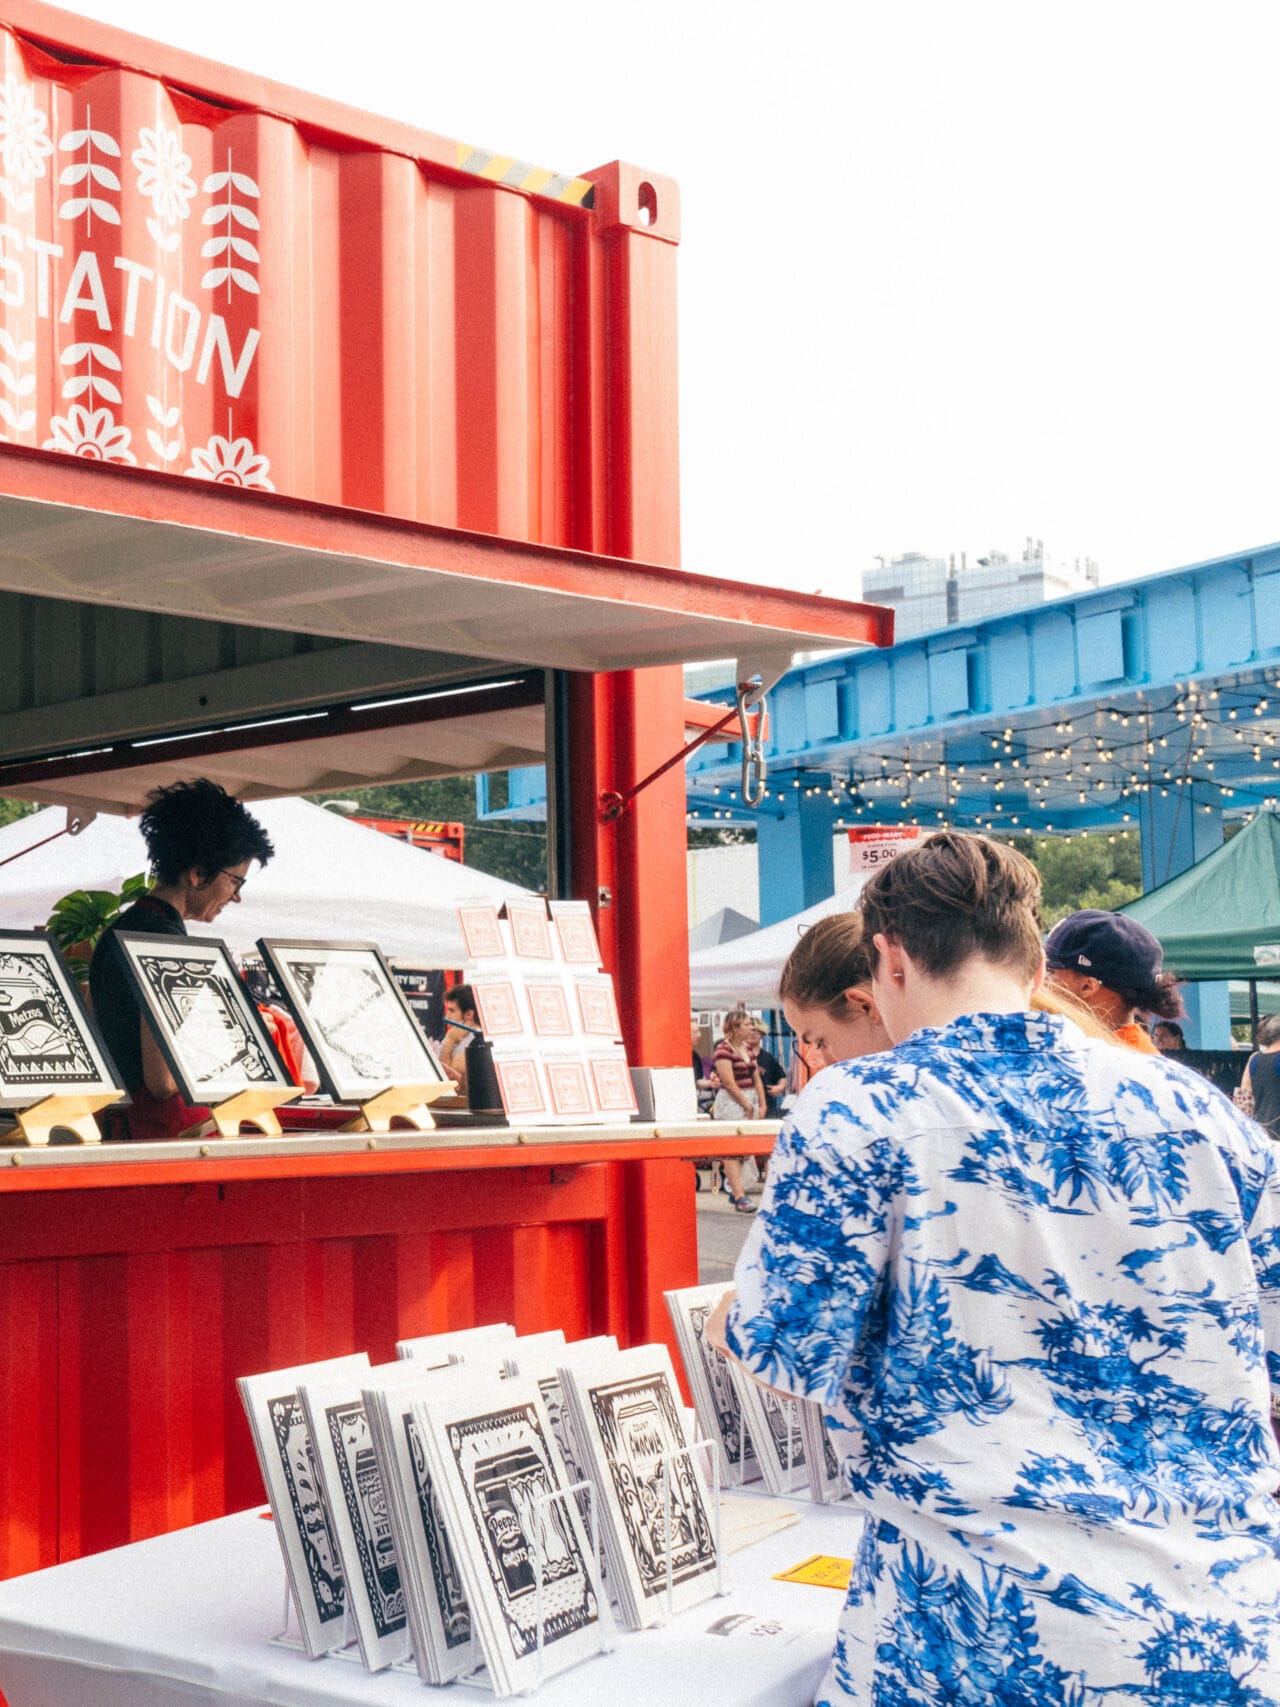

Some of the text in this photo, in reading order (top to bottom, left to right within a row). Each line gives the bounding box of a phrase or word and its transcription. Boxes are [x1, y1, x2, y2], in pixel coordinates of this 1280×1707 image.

[862, 849, 897, 863] $5.00
[8, 1007, 44, 1029] Matzos
[490, 1515, 518, 1536] Peeps
